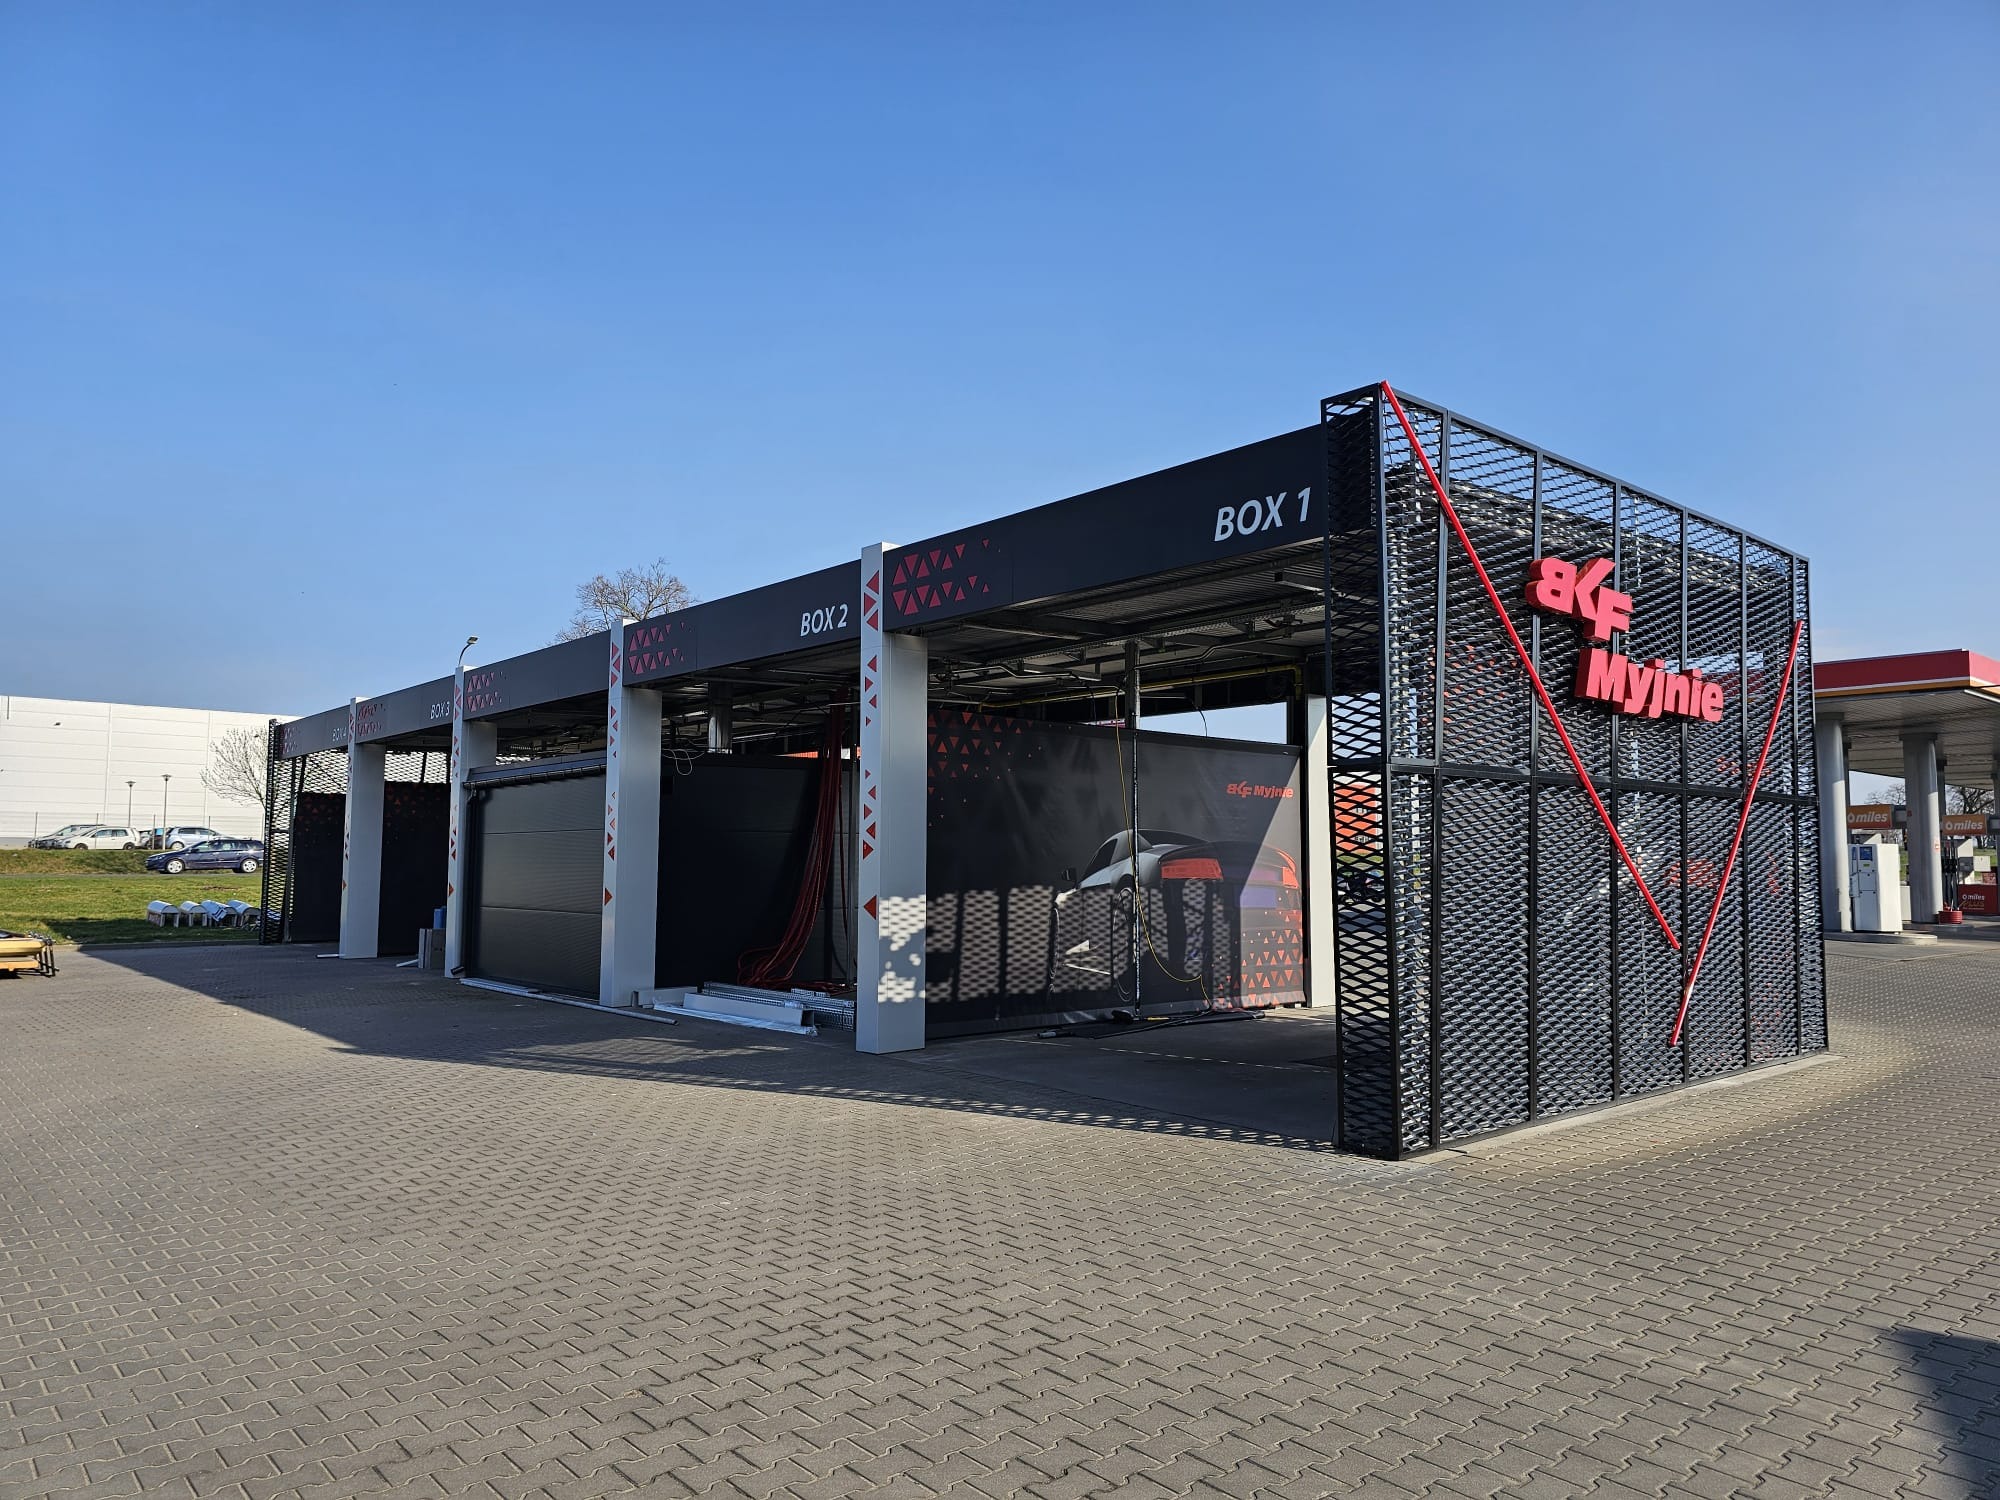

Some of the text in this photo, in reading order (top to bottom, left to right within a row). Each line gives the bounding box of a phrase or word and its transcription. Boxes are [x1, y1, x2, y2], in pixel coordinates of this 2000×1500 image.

[1214, 486, 1311, 542] BOX 1
[800, 603, 848, 637] BOX 2
[1575, 647, 1725, 723] Myjnie
[430, 700, 450, 720] BOX 3
[1253, 784, 1293, 798] Myjnie
[1855, 812, 1888, 823] miles
[1953, 820, 1983, 830] miles
